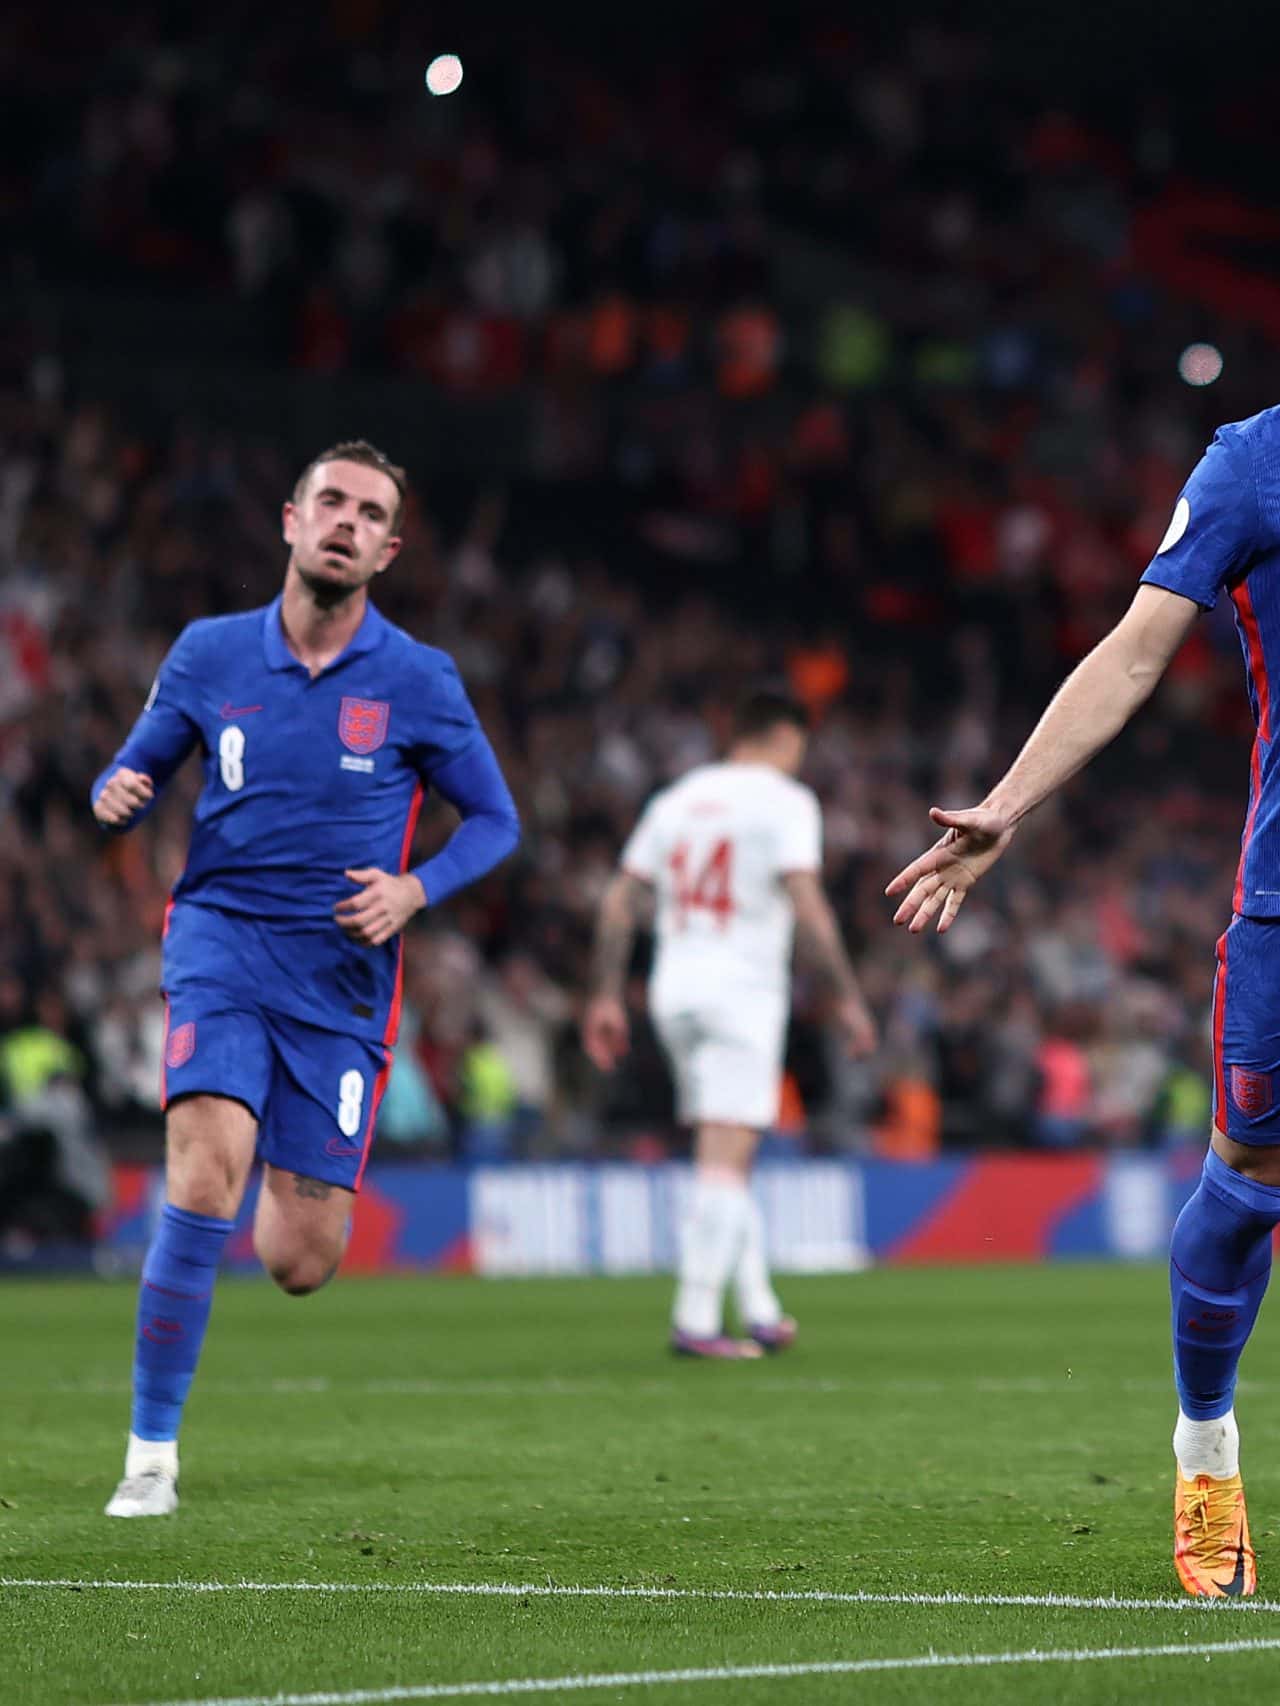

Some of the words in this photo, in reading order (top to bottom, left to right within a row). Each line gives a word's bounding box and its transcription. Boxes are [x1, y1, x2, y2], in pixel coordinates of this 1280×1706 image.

[219, 725, 246, 792] 8
[667, 836, 735, 931] 14
[338, 1068, 364, 1136] 8
